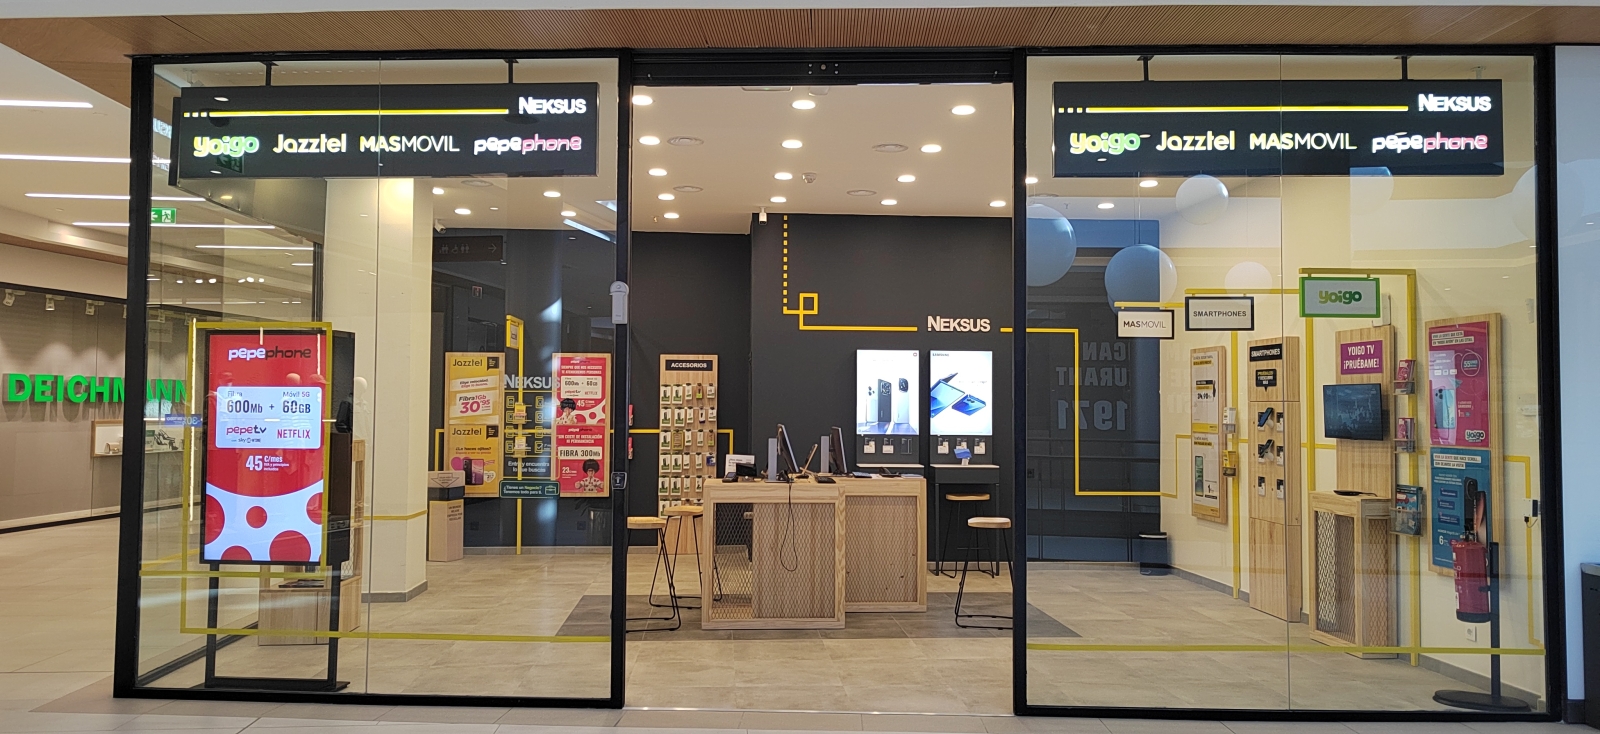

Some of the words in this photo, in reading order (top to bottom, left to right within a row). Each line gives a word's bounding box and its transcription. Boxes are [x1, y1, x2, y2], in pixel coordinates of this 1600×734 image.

[518, 96, 586, 114] NEKSUS
[1418, 94, 1491, 112] NEKSUS
[193, 135, 260, 157] yoigo
[272, 133, 347, 154] Jazztel
[359, 134, 460, 153] MASMOVIL
[473, 133, 582, 156] pepephone
[1069, 131, 1141, 155] yoigo
[1155, 130, 1236, 152] Jazztel
[1249, 132, 1357, 151] MASMOVIL
[1371, 131, 1488, 155] pepephone
[1318, 290, 1362, 305] yoigo
[1193, 310, 1247, 318] SMARTPHONES
[928, 316, 990, 332] NEKSUS
[1123, 320, 1166, 329] MASMOVIL
[228, 346, 312, 360] pepephone
[1250, 348, 1280, 358] SMARTPHONES
[1348, 346, 1366, 356] YOIGO
[1366, 344, 1374, 354] TV
[1344, 358, 1380, 370] ¡PRUÉBAME!
[504, 374, 560, 388] NEKSUS
[460, 400, 480, 414] 30
[277, 429, 310, 439] NETFLIX
[452, 428, 482, 436] Jazztel
[246, 455, 264, 471] 45
[1439, 536, 1444, 545] 6
